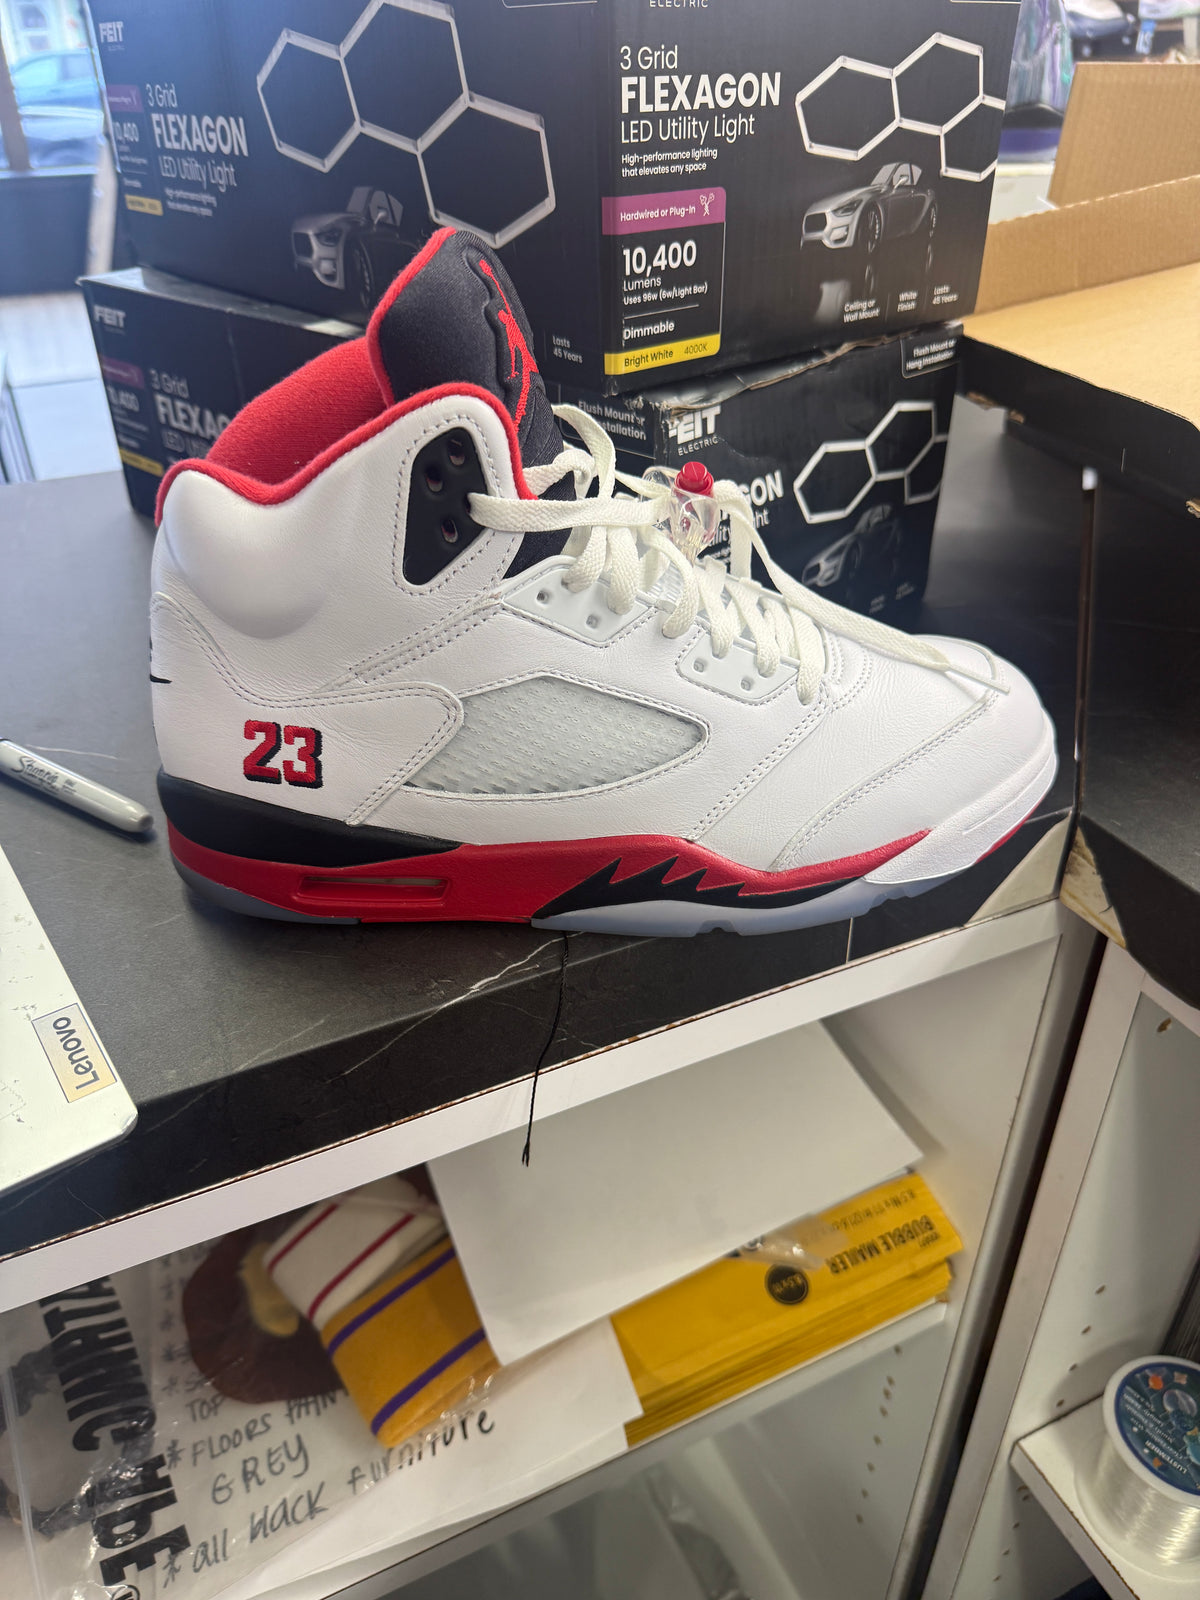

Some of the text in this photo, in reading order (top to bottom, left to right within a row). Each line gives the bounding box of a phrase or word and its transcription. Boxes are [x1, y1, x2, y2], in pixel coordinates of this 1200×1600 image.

[99, 21, 124, 43] FEIT
[620, 44, 678, 70] 3 Grid
[146, 83, 177, 108] 3 Grid
[621, 72, 781, 114] FLEXAGON
[151, 113, 248, 157] FLEXAGON
[621, 113, 755, 146] LED Utility Light
[621, 147, 718, 167] High-performance lighting
[158, 155, 237, 192] LED Utility Light
[621, 161, 707, 178] that elevates any space
[620, 204, 696, 222] Hardwired or Plug-In
[623, 240, 697, 278] 10,400
[623, 277, 662, 292] Lumens
[623, 293, 642, 305] Uses
[642, 291, 658, 302] 96w
[693, 281, 709, 296] Bar)
[93, 304, 126, 328] FEIT
[552, 335, 570, 348] Lasts
[623, 319, 675, 340] Dimmable
[553, 349, 583, 364] 45 Years
[624, 343, 708, 368] Bright White 4000K
[150, 368, 161, 390] 3
[160, 371, 189, 399] Grid
[578, 400, 603, 416] Flush
[604, 405, 634, 424] Mount
[600, 420, 647, 441] stallation
[678, 435, 719, 456] ELECTRIC
[243, 719, 323, 788] 23
[52, 1016, 101, 1090] Lenovo
[191, 1412, 272, 1466] FLOORS
[211, 1433, 310, 1504] GREY
